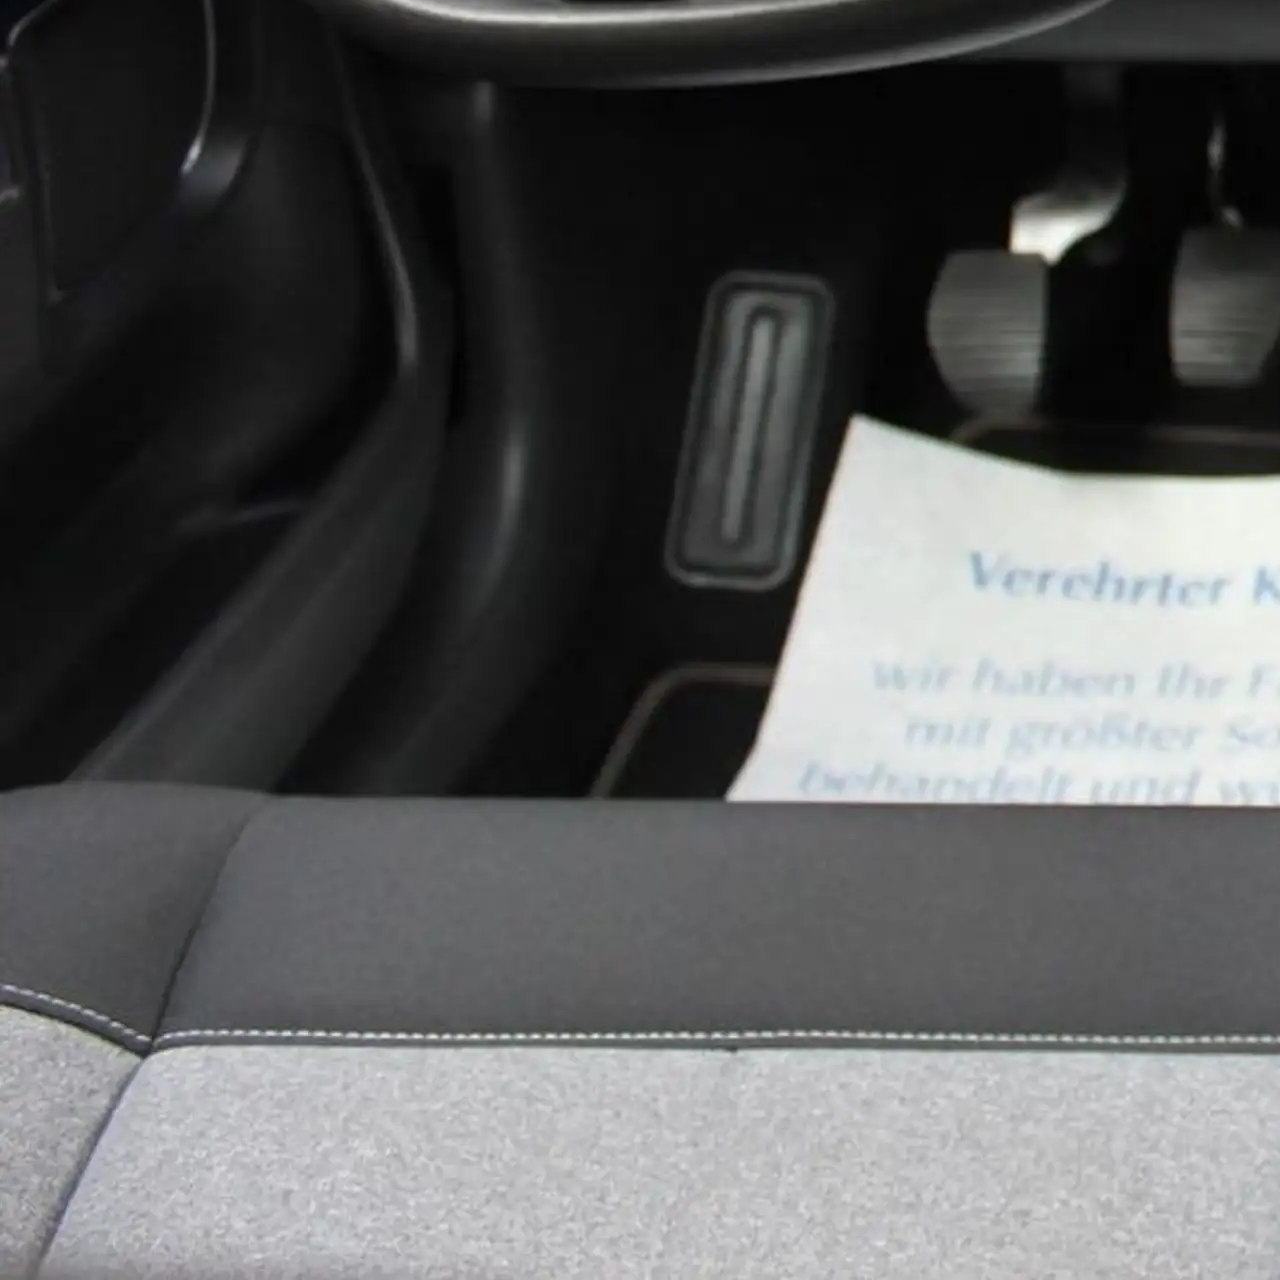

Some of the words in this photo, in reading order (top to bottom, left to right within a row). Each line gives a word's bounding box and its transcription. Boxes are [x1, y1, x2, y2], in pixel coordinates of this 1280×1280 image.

[969, 550, 1232, 608] Verehrter
[872, 658, 955, 691] wir
[971, 657, 1136, 698] haben
[1156, 663, 1228, 699] Ihr
[903, 715, 994, 748] mit
[797, 760, 1072, 803] behandelt
[1089, 766, 1201, 806] und
